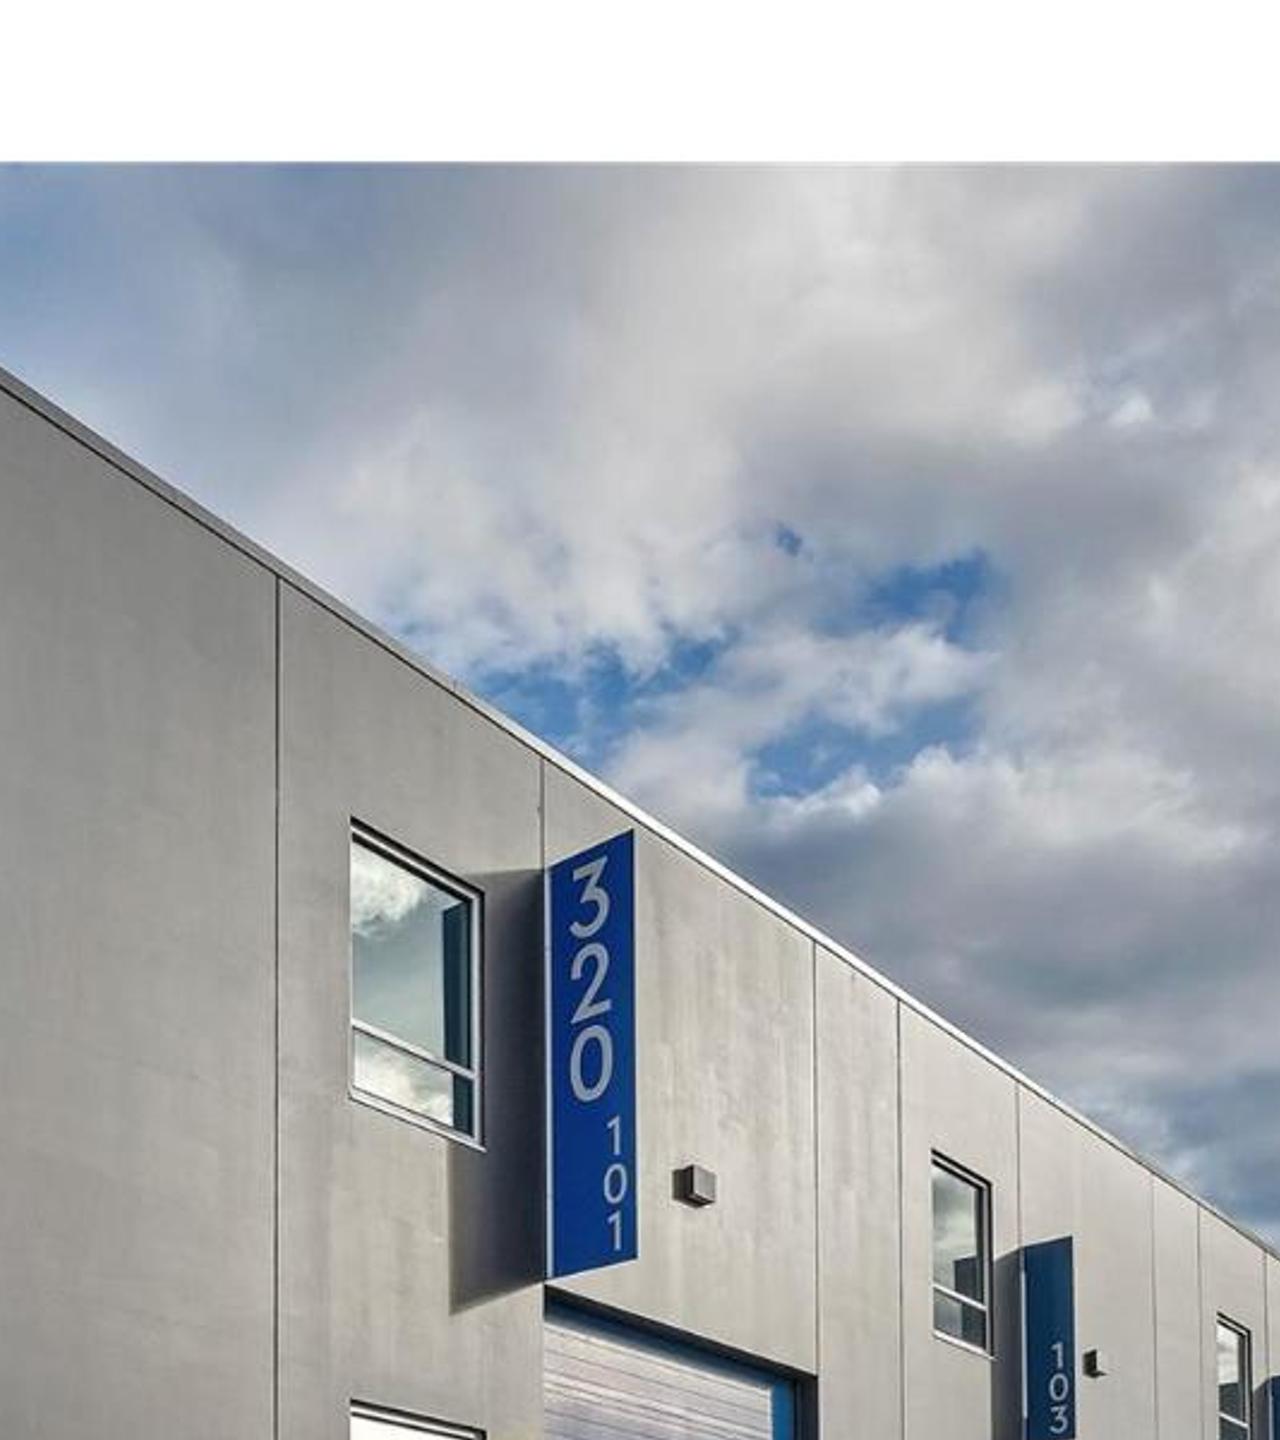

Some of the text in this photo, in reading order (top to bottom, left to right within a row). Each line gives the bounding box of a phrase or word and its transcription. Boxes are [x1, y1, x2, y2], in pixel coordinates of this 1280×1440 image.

[569, 855, 613, 1103] 320
[603, 1114, 628, 1252] 101
[1048, 1341, 1070, 1435] 103
